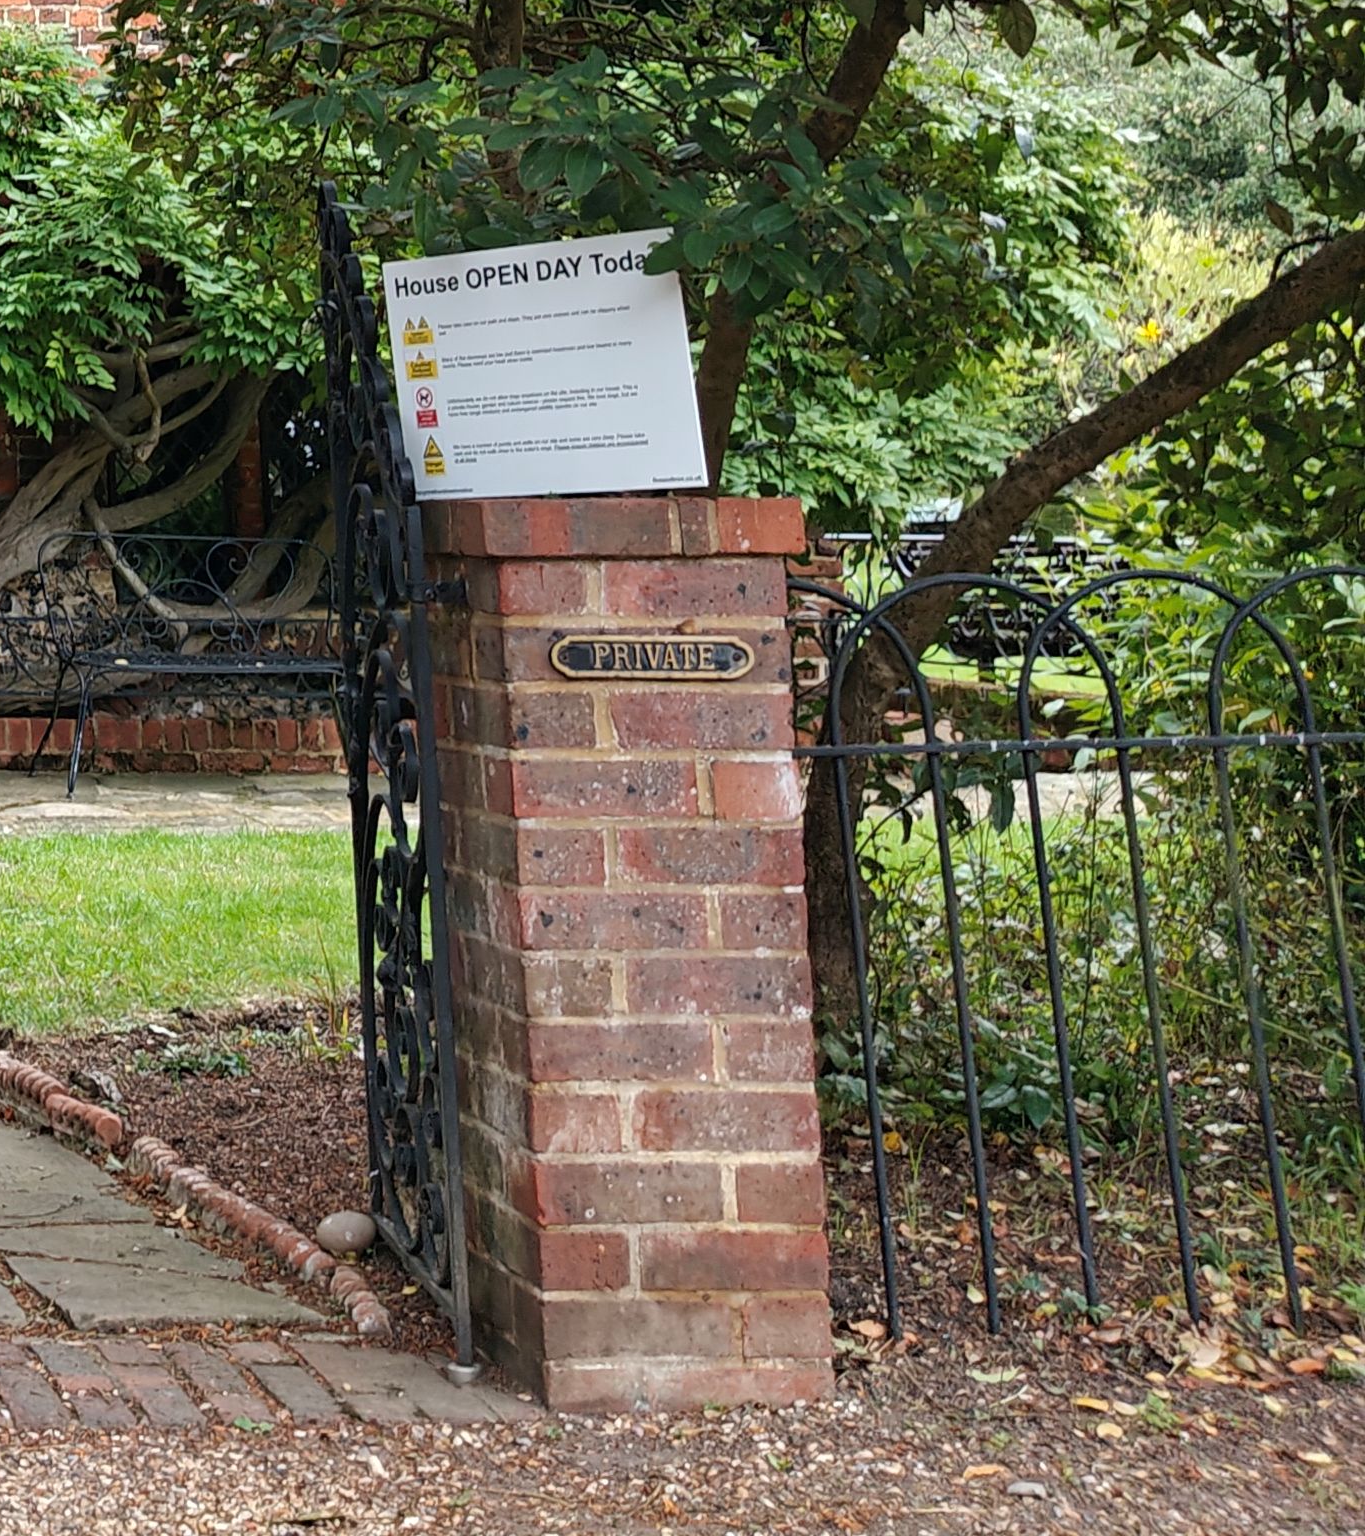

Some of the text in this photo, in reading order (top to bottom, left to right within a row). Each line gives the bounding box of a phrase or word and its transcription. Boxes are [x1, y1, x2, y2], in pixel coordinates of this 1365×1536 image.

[394, 250, 646, 298] House OPEN DAY Toda
[592, 642, 716, 670] PRIVATE
